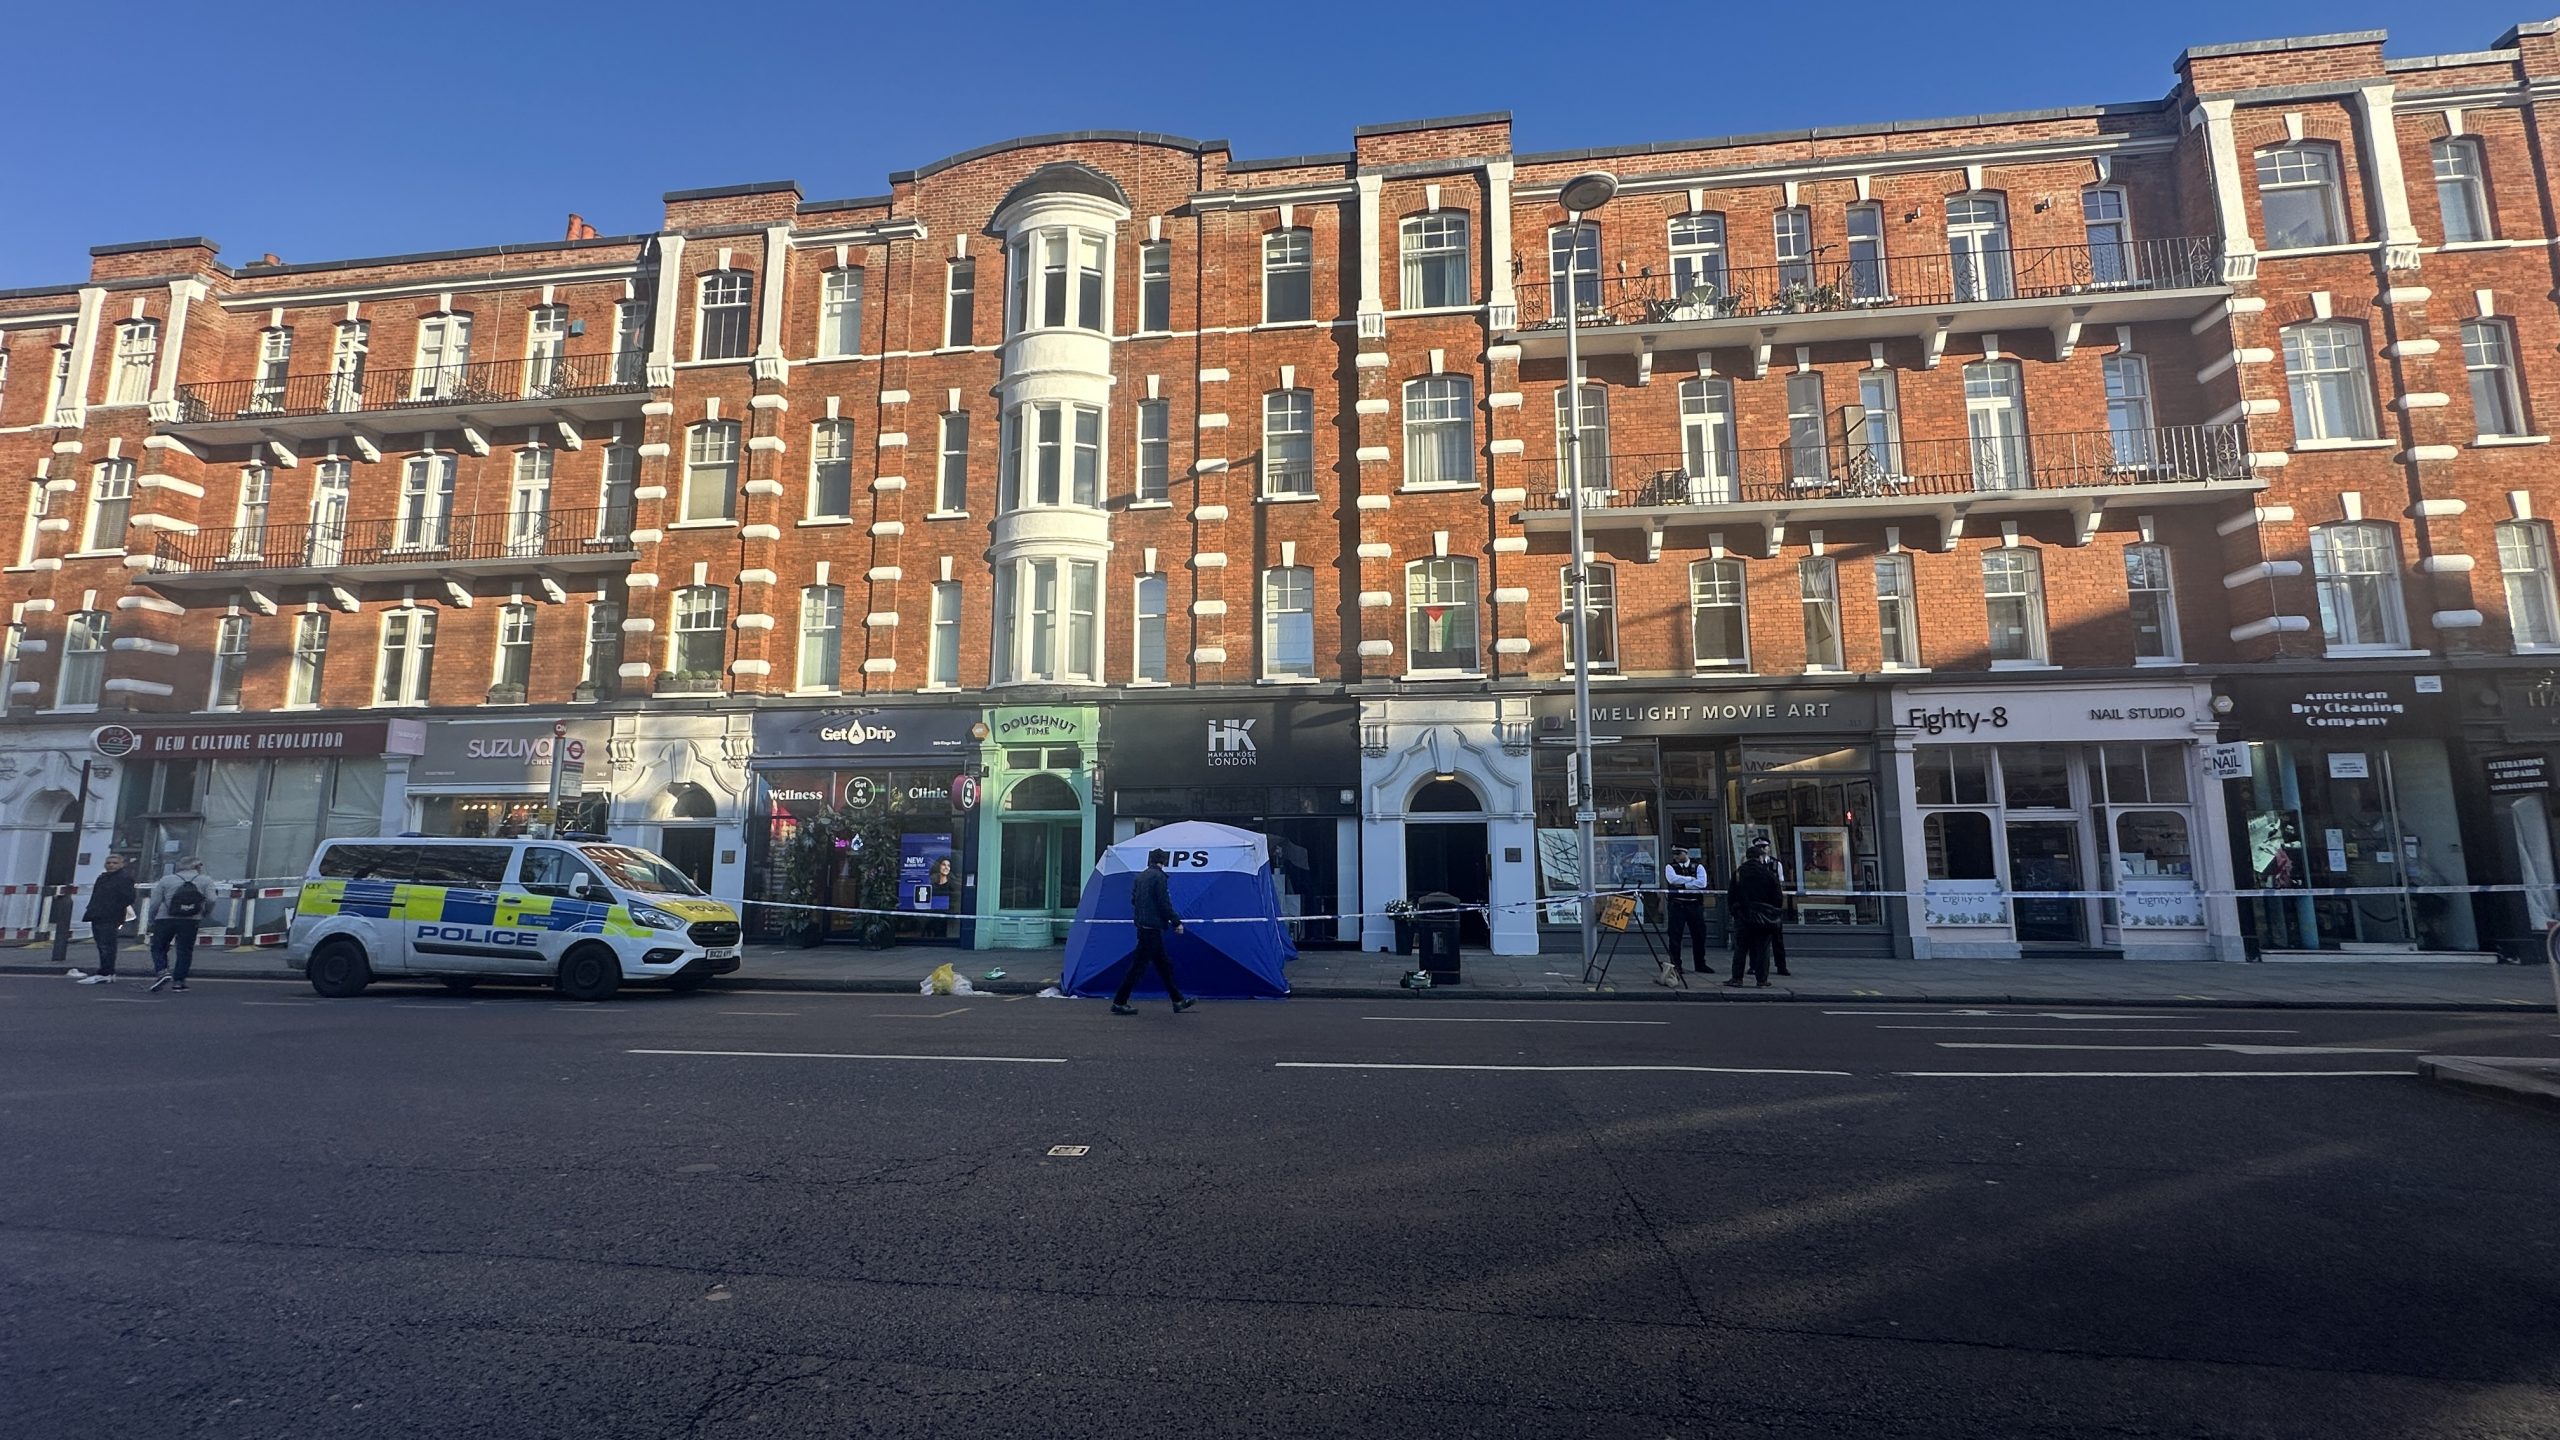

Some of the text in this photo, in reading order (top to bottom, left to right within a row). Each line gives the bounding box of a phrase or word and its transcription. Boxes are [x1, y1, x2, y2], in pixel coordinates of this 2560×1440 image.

[1570, 703, 1830, 721] LMELIGHT MOVIE ART
[2090, 707, 2185, 720] NAIL STUDIO
[2291, 702, 2404, 714] Dry Cleaning
[1001, 715, 1077, 734] DOUGHNUT
[1908, 706, 2008, 735] Eighty-8
[2306, 716, 2388, 727] Company
[820, 727, 847, 741] Get
[866, 726, 896, 742] Drip
[1024, 727, 1050, 735] TIME
[1208, 719, 1257, 751] HK
[155, 735, 186, 750] NEW
[192, 735, 252, 750] CULTURE
[257, 732, 343, 749] REVOLUTION
[467, 738, 555, 765] suzuya
[531, 758, 553, 766] CHEL
[1208, 758, 1257, 766] LONDON
[2212, 755, 2241, 769] NAIL
[768, 789, 823, 800] Wellness
[908, 787, 948, 799] Clinic
[852, 796, 867, 804] Drip
[906, 856, 924, 864] NEW
[417, 925, 539, 946] POLICE
